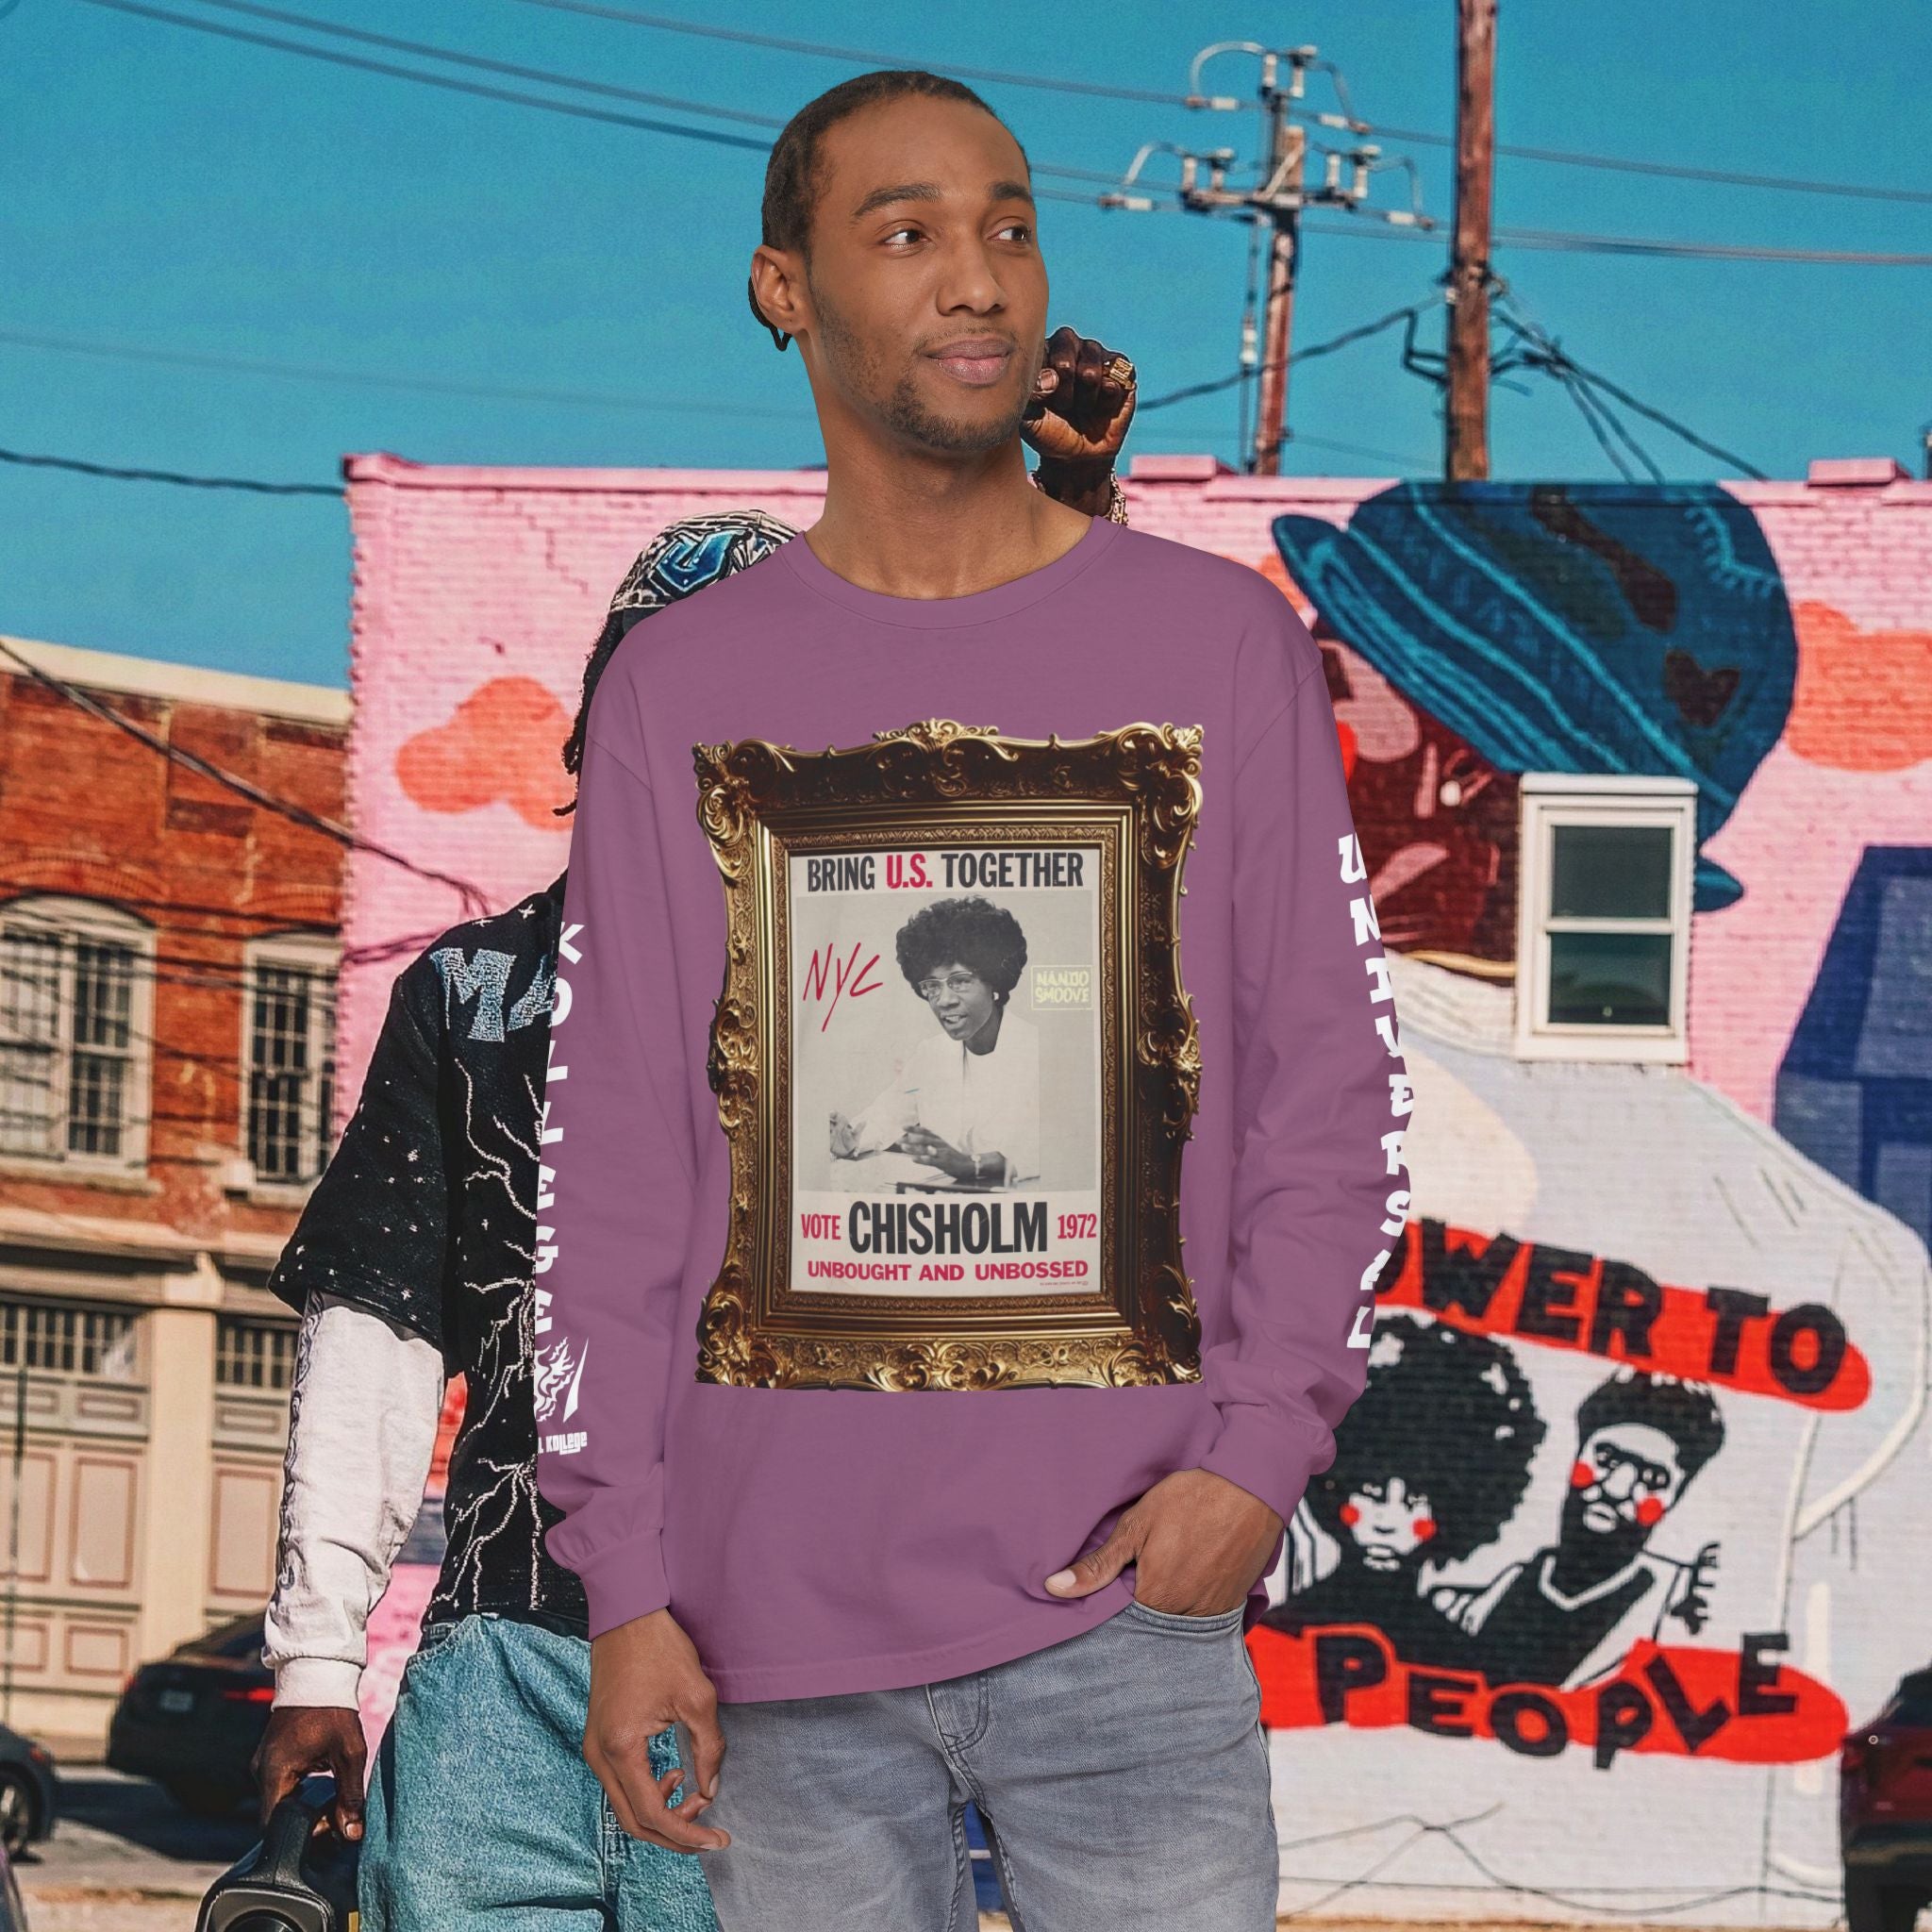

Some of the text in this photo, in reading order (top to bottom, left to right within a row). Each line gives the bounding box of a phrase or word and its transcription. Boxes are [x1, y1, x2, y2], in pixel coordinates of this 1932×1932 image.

[808, 852, 1084, 891] BRING U.S. TOGETHER
[803, 941, 883, 1033] NYC
[1035, 987, 1090, 1003] SMOOVE
[1037, 970, 1090, 987] NANDO
[801, 1200, 1098, 1256] VOTE CHISHOLM 1972
[807, 1259, 1089, 1281] UNBOUGHT AND UNBOSSED
[1375, 1216, 1846, 1395] WER TO
[1315, 1632, 1797, 1770] PEOPLE
